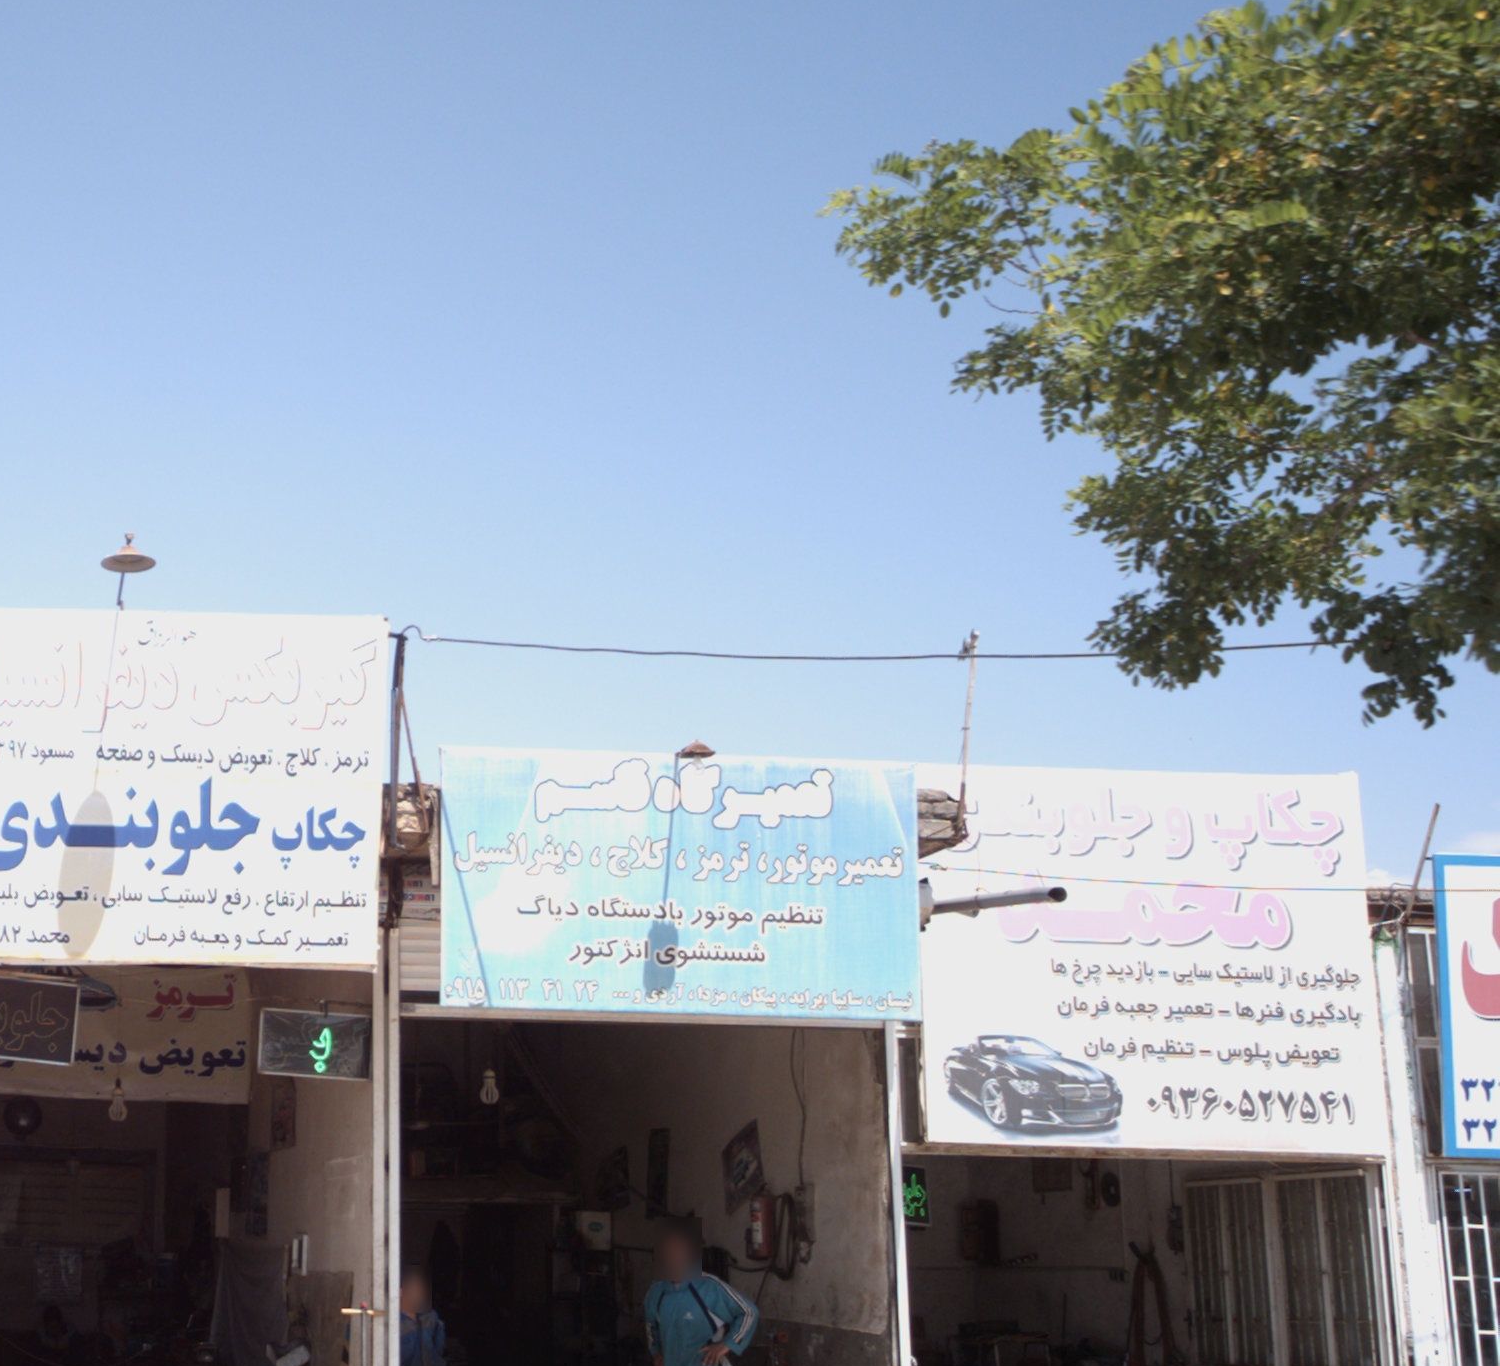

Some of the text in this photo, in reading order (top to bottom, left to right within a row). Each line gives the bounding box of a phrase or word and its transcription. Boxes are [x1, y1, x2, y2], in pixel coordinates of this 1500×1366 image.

[30, 744, 75, 765] مسعود
[95, 743, 143, 764] صفحه
[147, 750, 156, 769] و
[160, 744, 214, 770] دیسک
[218, 746, 273, 774] تعویض
[331, 752, 369, 773] ترمز
[271, 804, 367, 869] چکاپ
[1164, 804, 1194, 860] و
[1204, 788, 1345, 877] چکاپ
[452, 830, 584, 876] دیفرانسیل
[692, 840, 750, 883] ترمز
[837, 846, 904, 886] تعمیر
[23, 885, 89, 908] تعویض
[147, 885, 218, 910] لاستیک
[221, 887, 252, 915] رفع
[264, 888, 310, 916] ارتفاع
[312, 889, 368, 918] تنظیم
[516, 894, 580, 922] دیاگ
[689, 908, 753, 930] موتور
[760, 904, 825, 934] تنظیم
[25, 930, 71, 945] محمد
[133, 924, 349, 952] تعمیر کمک و جعبه فرمان
[654, 940, 766, 968] شستشوی
[1050, 957, 1068, 975] ها
[1072, 958, 1102, 985] چرخ
[1105, 959, 1155, 983] بازدید
[1216, 962, 1274, 986] لاستیک
[1278, 965, 1292, 986] از
[1296, 963, 1361, 990] جلوگیری
[146, 973, 237, 1021] ترمز
[1056, 995, 1111, 1018] فرمان
[1114, 1000, 1159, 1019] جعبه
[1164, 1001, 1214, 1021] تعمیر
[74, 1040, 128, 1071] دیس
[139, 1038, 246, 1077] تعویض
[1083, 1036, 1137, 1060] فرمان
[1140, 1038, 1195, 1062] تنظیم
[1216, 1041, 1272, 1069] پلوس
[1275, 1043, 1342, 1068] تعویض
[1460, 1078, 1500, 1102] ۳۲
[1146, 1085, 1355, 1124] ۰۹۳۶۰۵۲۷۵۴۱
